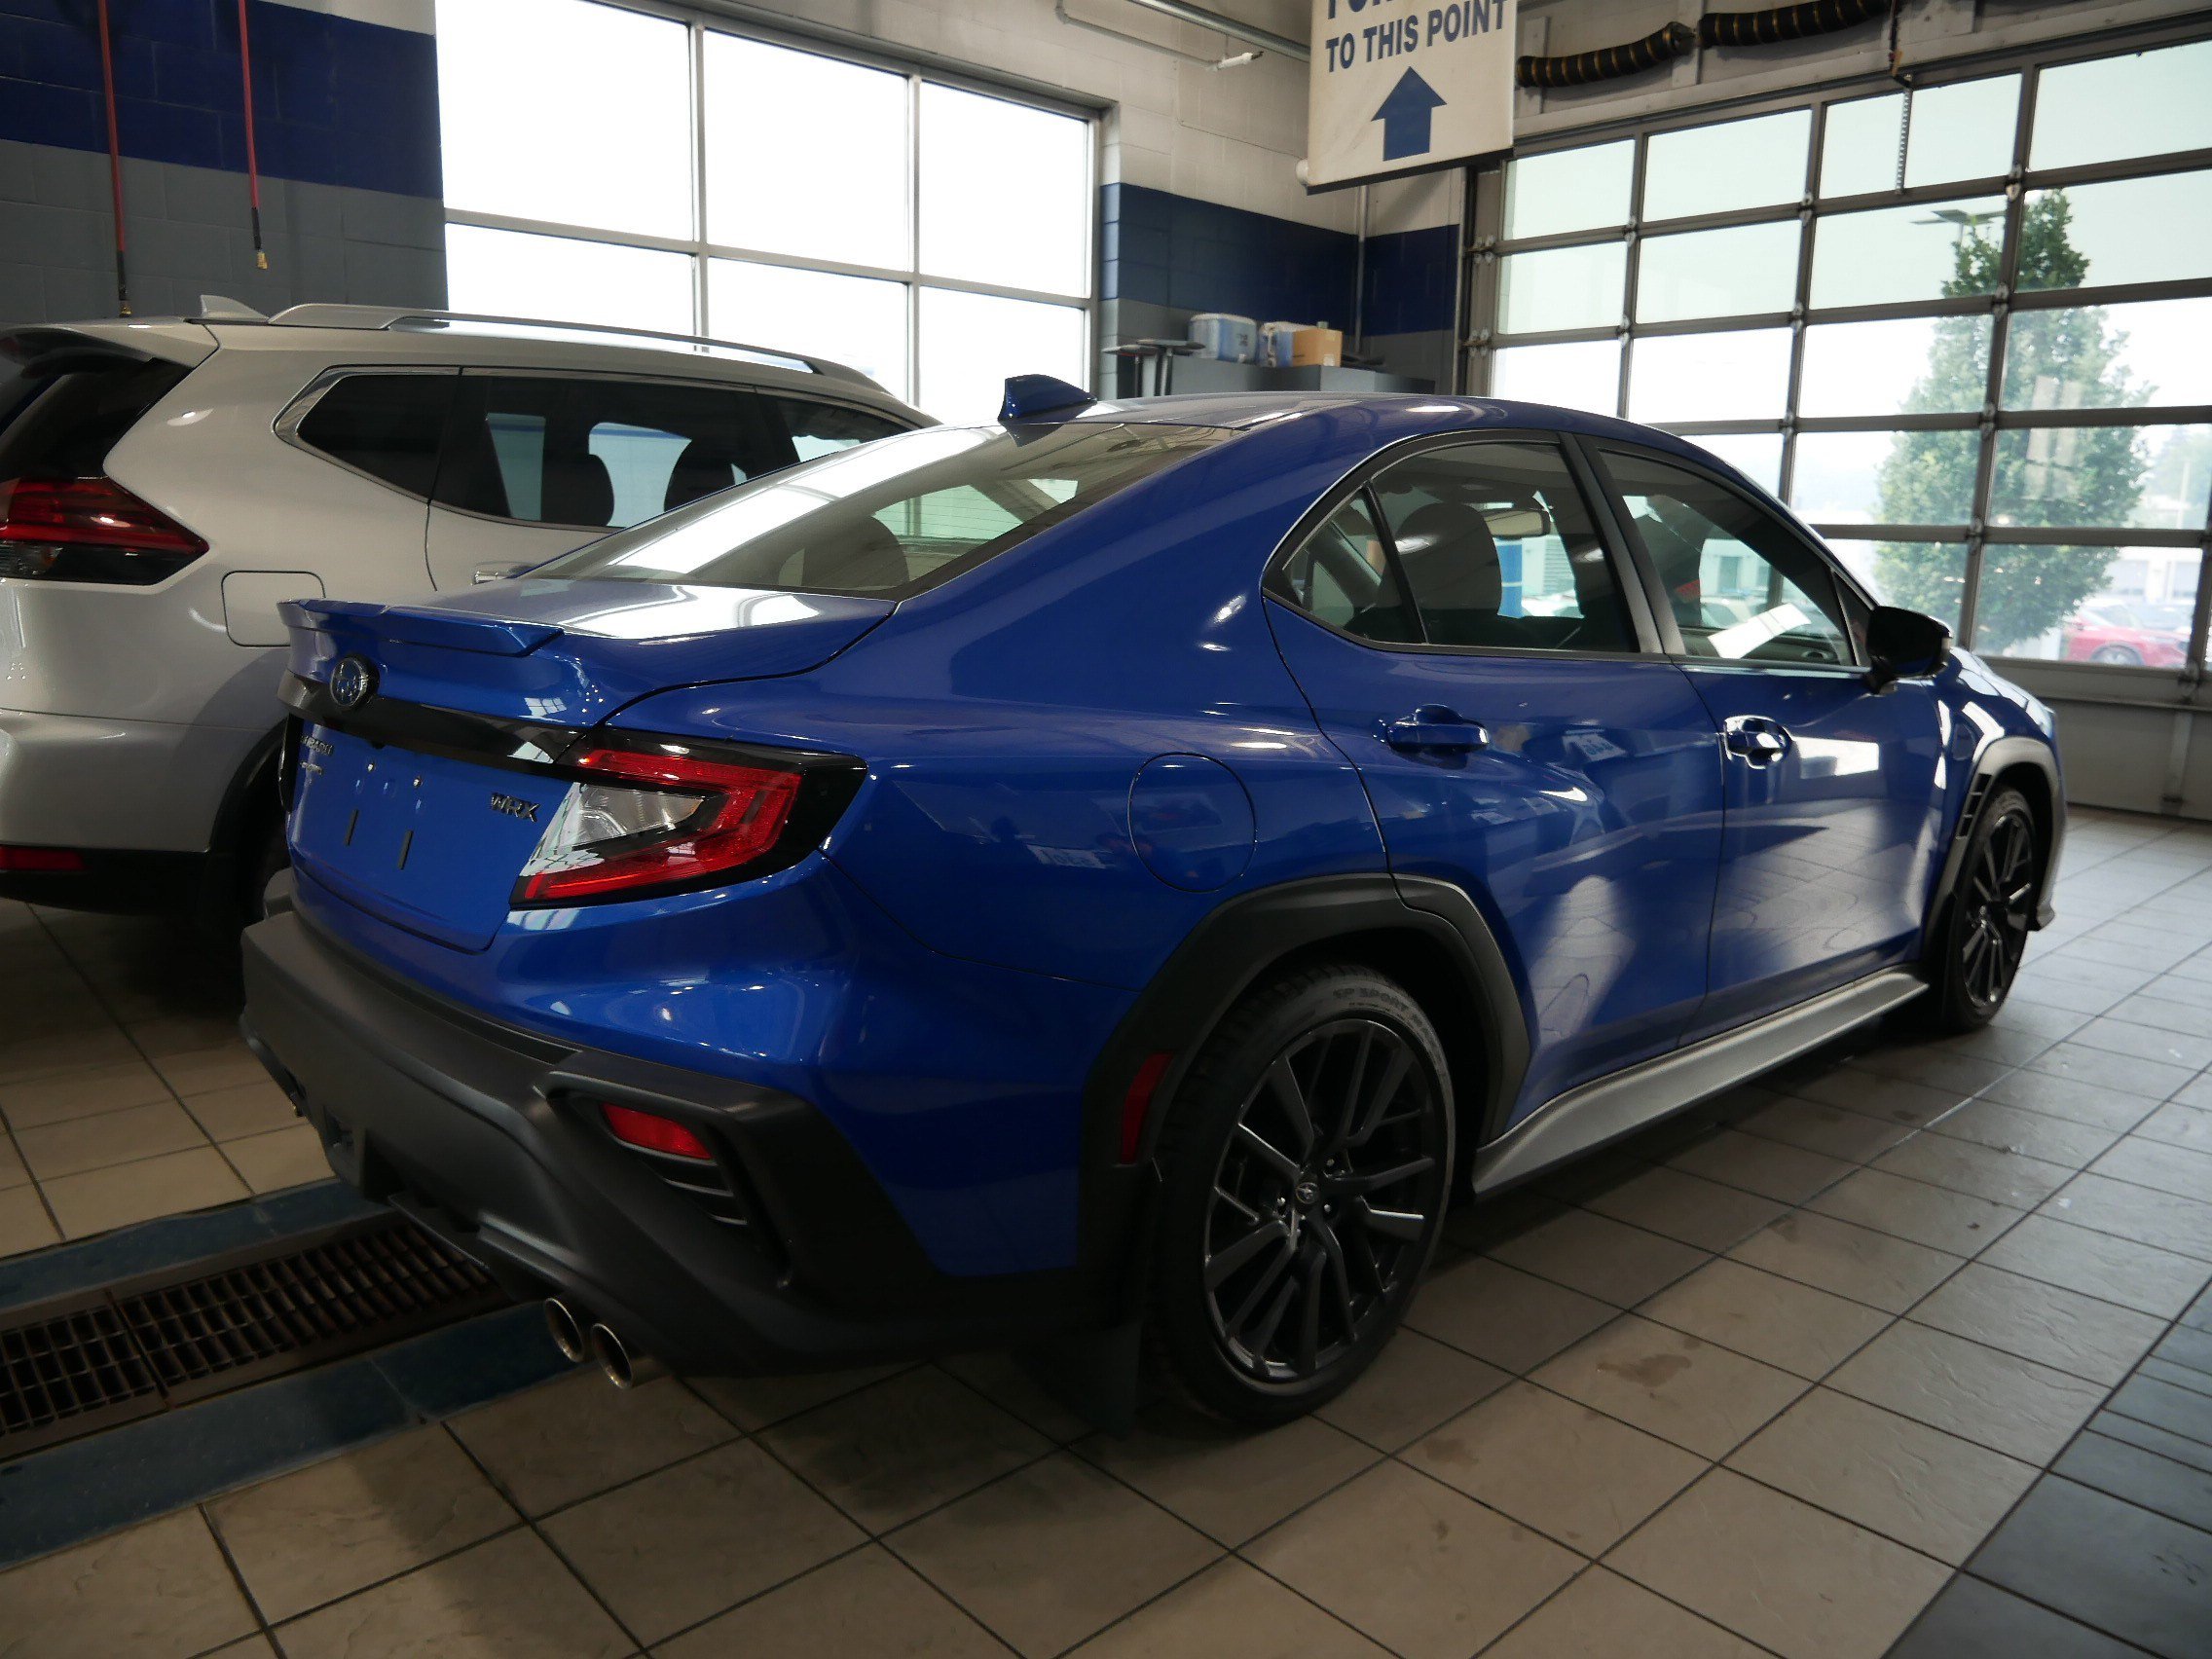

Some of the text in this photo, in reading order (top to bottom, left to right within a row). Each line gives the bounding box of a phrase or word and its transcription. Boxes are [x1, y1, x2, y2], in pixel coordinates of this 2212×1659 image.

[1325, 32, 1355, 73] TO
[1363, 15, 1419, 62] THIS
[1426, 0, 1506, 47] POINT
[491, 793, 540, 823] WRX
